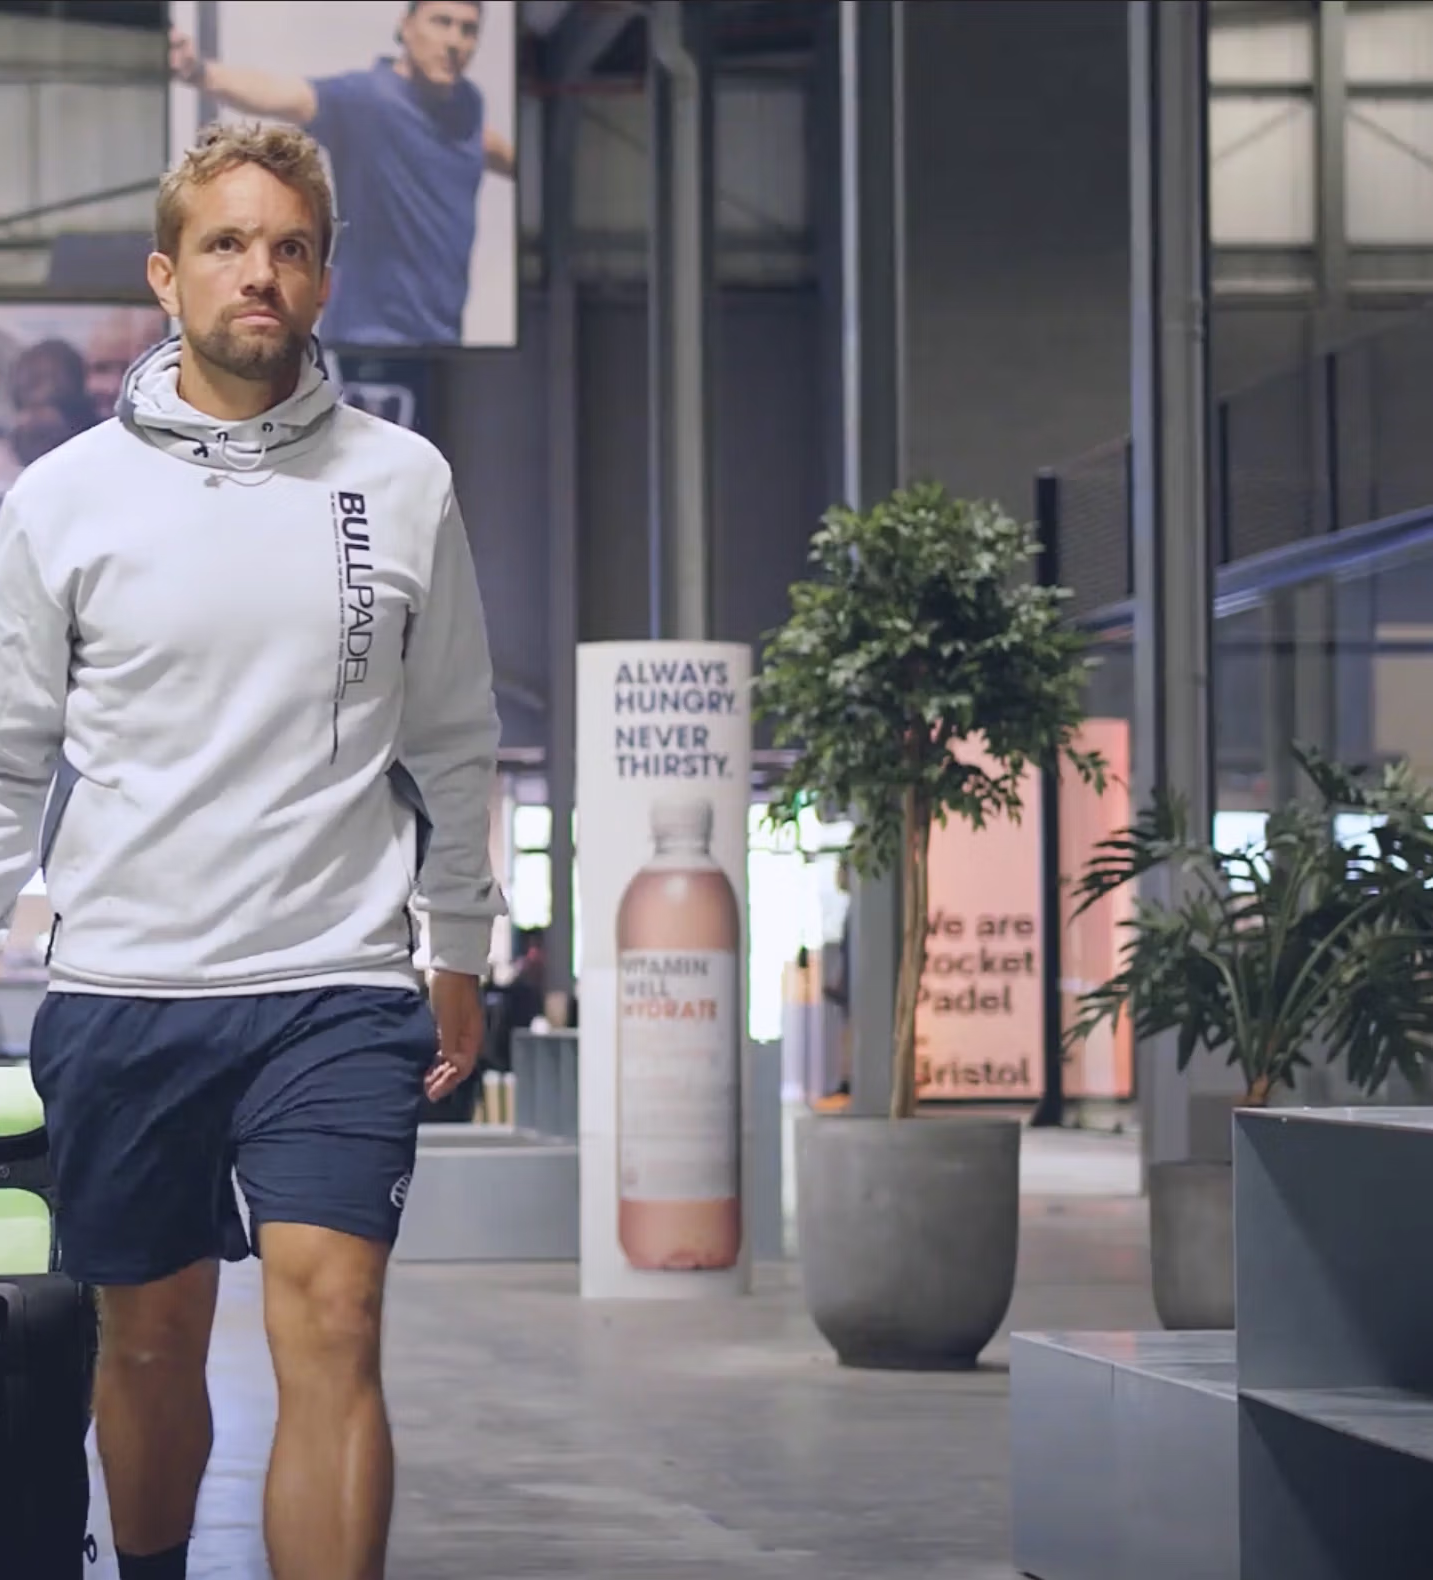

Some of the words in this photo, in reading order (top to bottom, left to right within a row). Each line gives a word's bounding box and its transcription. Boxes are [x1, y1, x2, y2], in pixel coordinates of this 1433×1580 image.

[337, 490, 375, 700] BULLPADEL
[616, 661, 729, 684] ALWAYS
[615, 689, 740, 714] HUNGRY.
[615, 725, 709, 748] NEVER
[617, 753, 733, 777] THIRSTY.
[976, 913, 1034, 937] are
[621, 955, 710, 976] VITAMIN
[924, 947, 1035, 974] ocket
